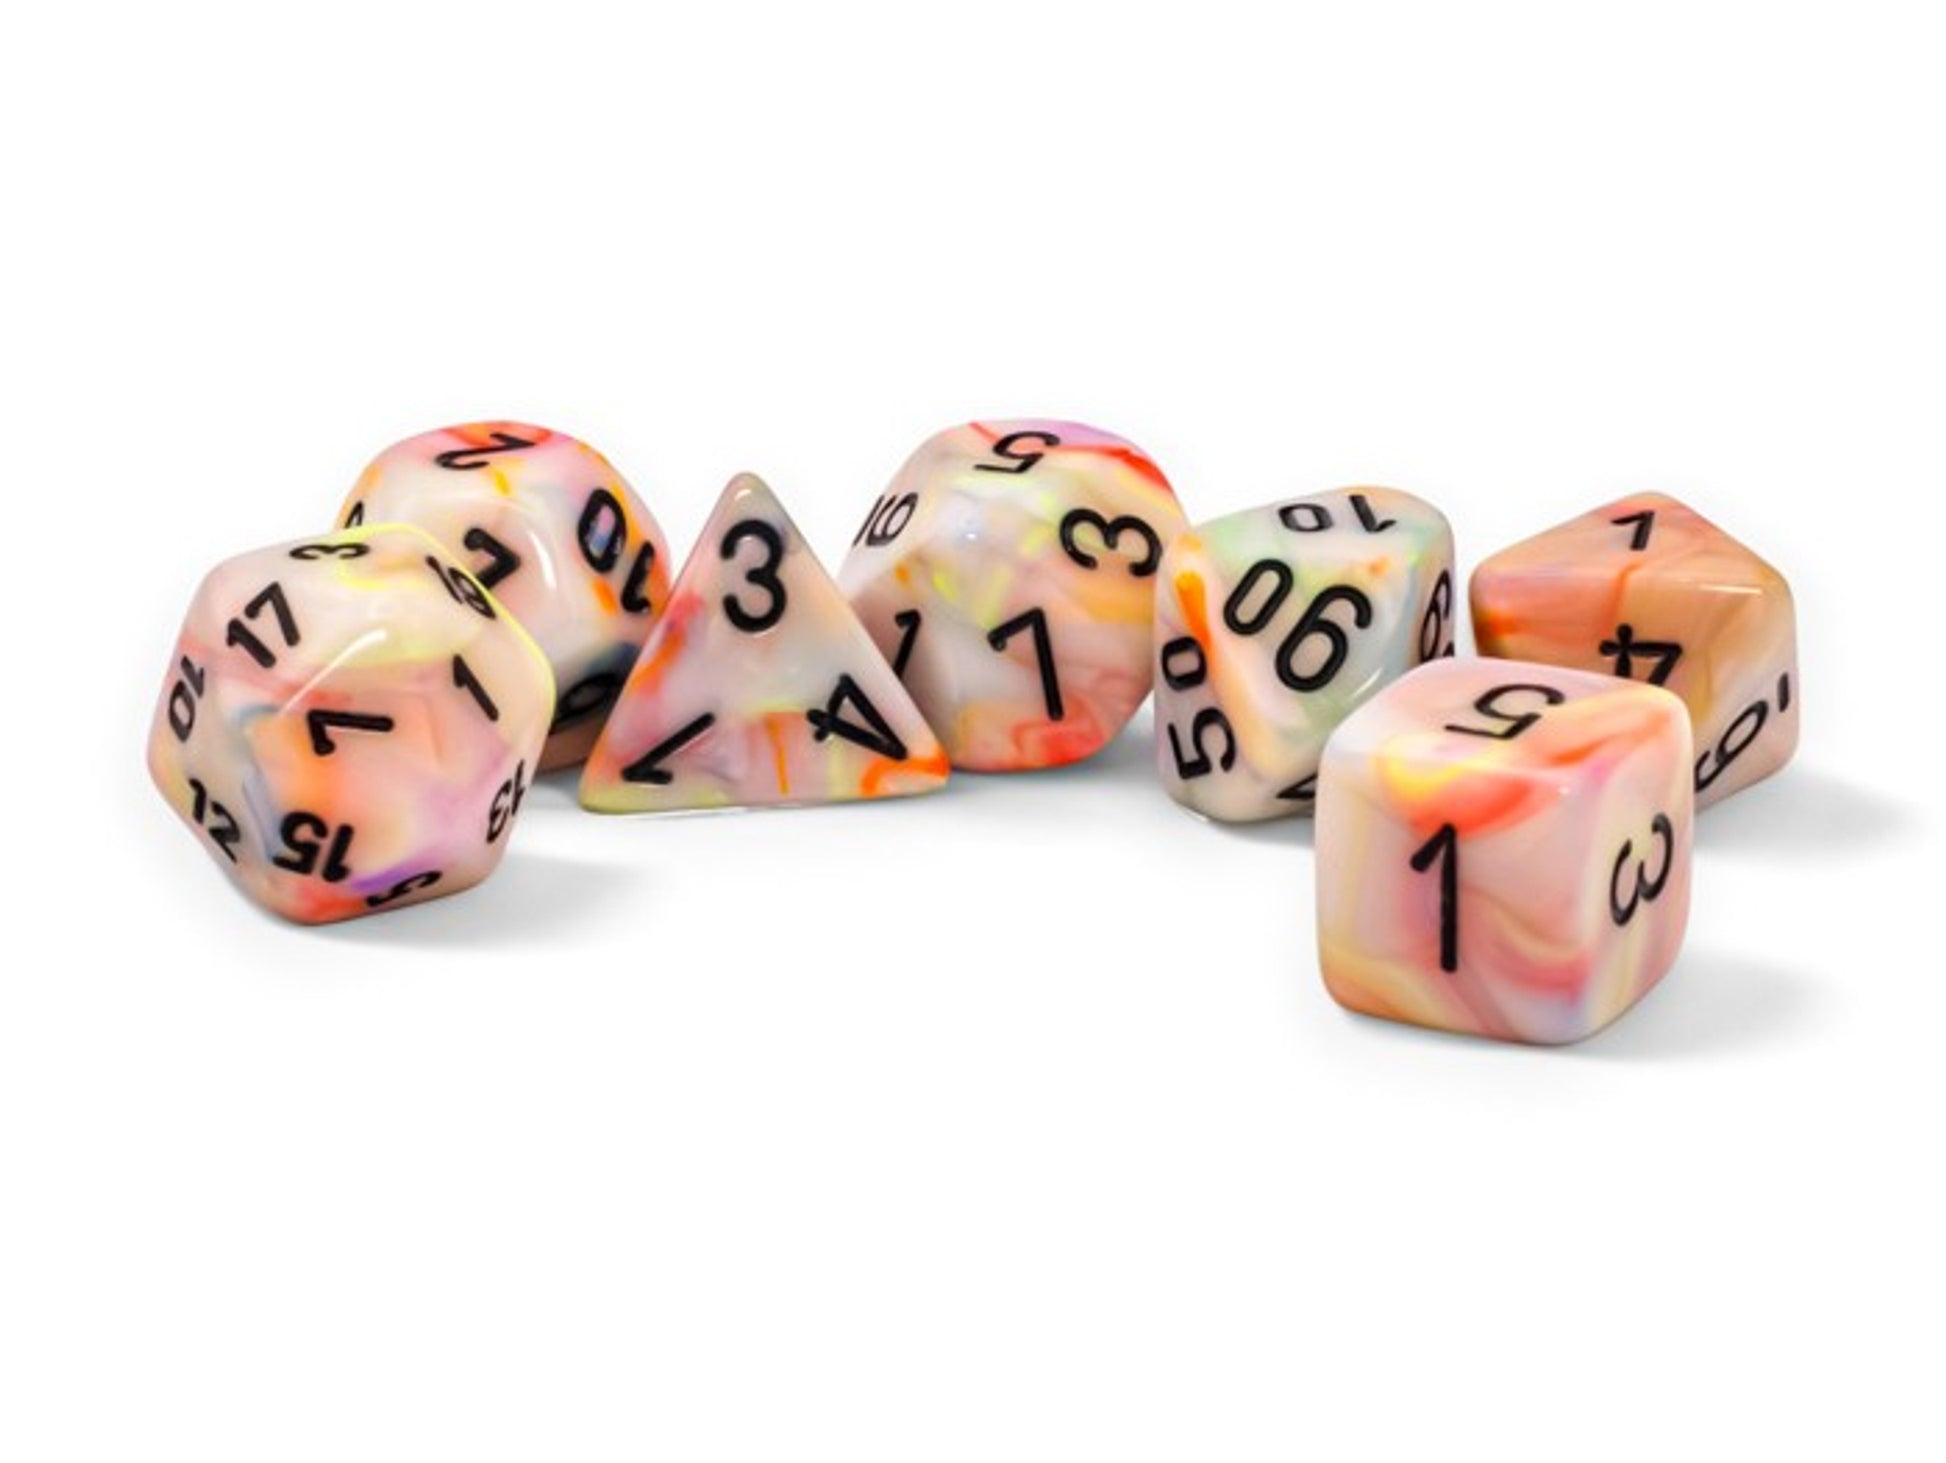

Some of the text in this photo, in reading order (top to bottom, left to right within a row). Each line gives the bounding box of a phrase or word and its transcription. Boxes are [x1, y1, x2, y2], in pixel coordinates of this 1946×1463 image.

[435, 433, 536, 470] 2
[973, 431, 1060, 473] 5
[577, 488, 655, 613] 10
[1059, 508, 1163, 577] 3
[1278, 494, 1397, 533] 10
[720, 519, 786, 632] 3
[226, 581, 300, 669] 17
[987, 607, 1064, 721] 7
[1599, 623, 1684, 687] 4
[168, 655, 205, 742] 10
[452, 653, 500, 722] 1
[806, 674, 909, 760] 4
[1160, 635, 1237, 780] 50
[1445, 683, 1567, 740] 5
[307, 708, 396, 756] 7
[188, 777, 241, 864] 12
[486, 758, 526, 844] 13
[272, 811, 354, 882] 15
[1609, 812, 1675, 926] 3
[1410, 822, 1459, 972] 1
